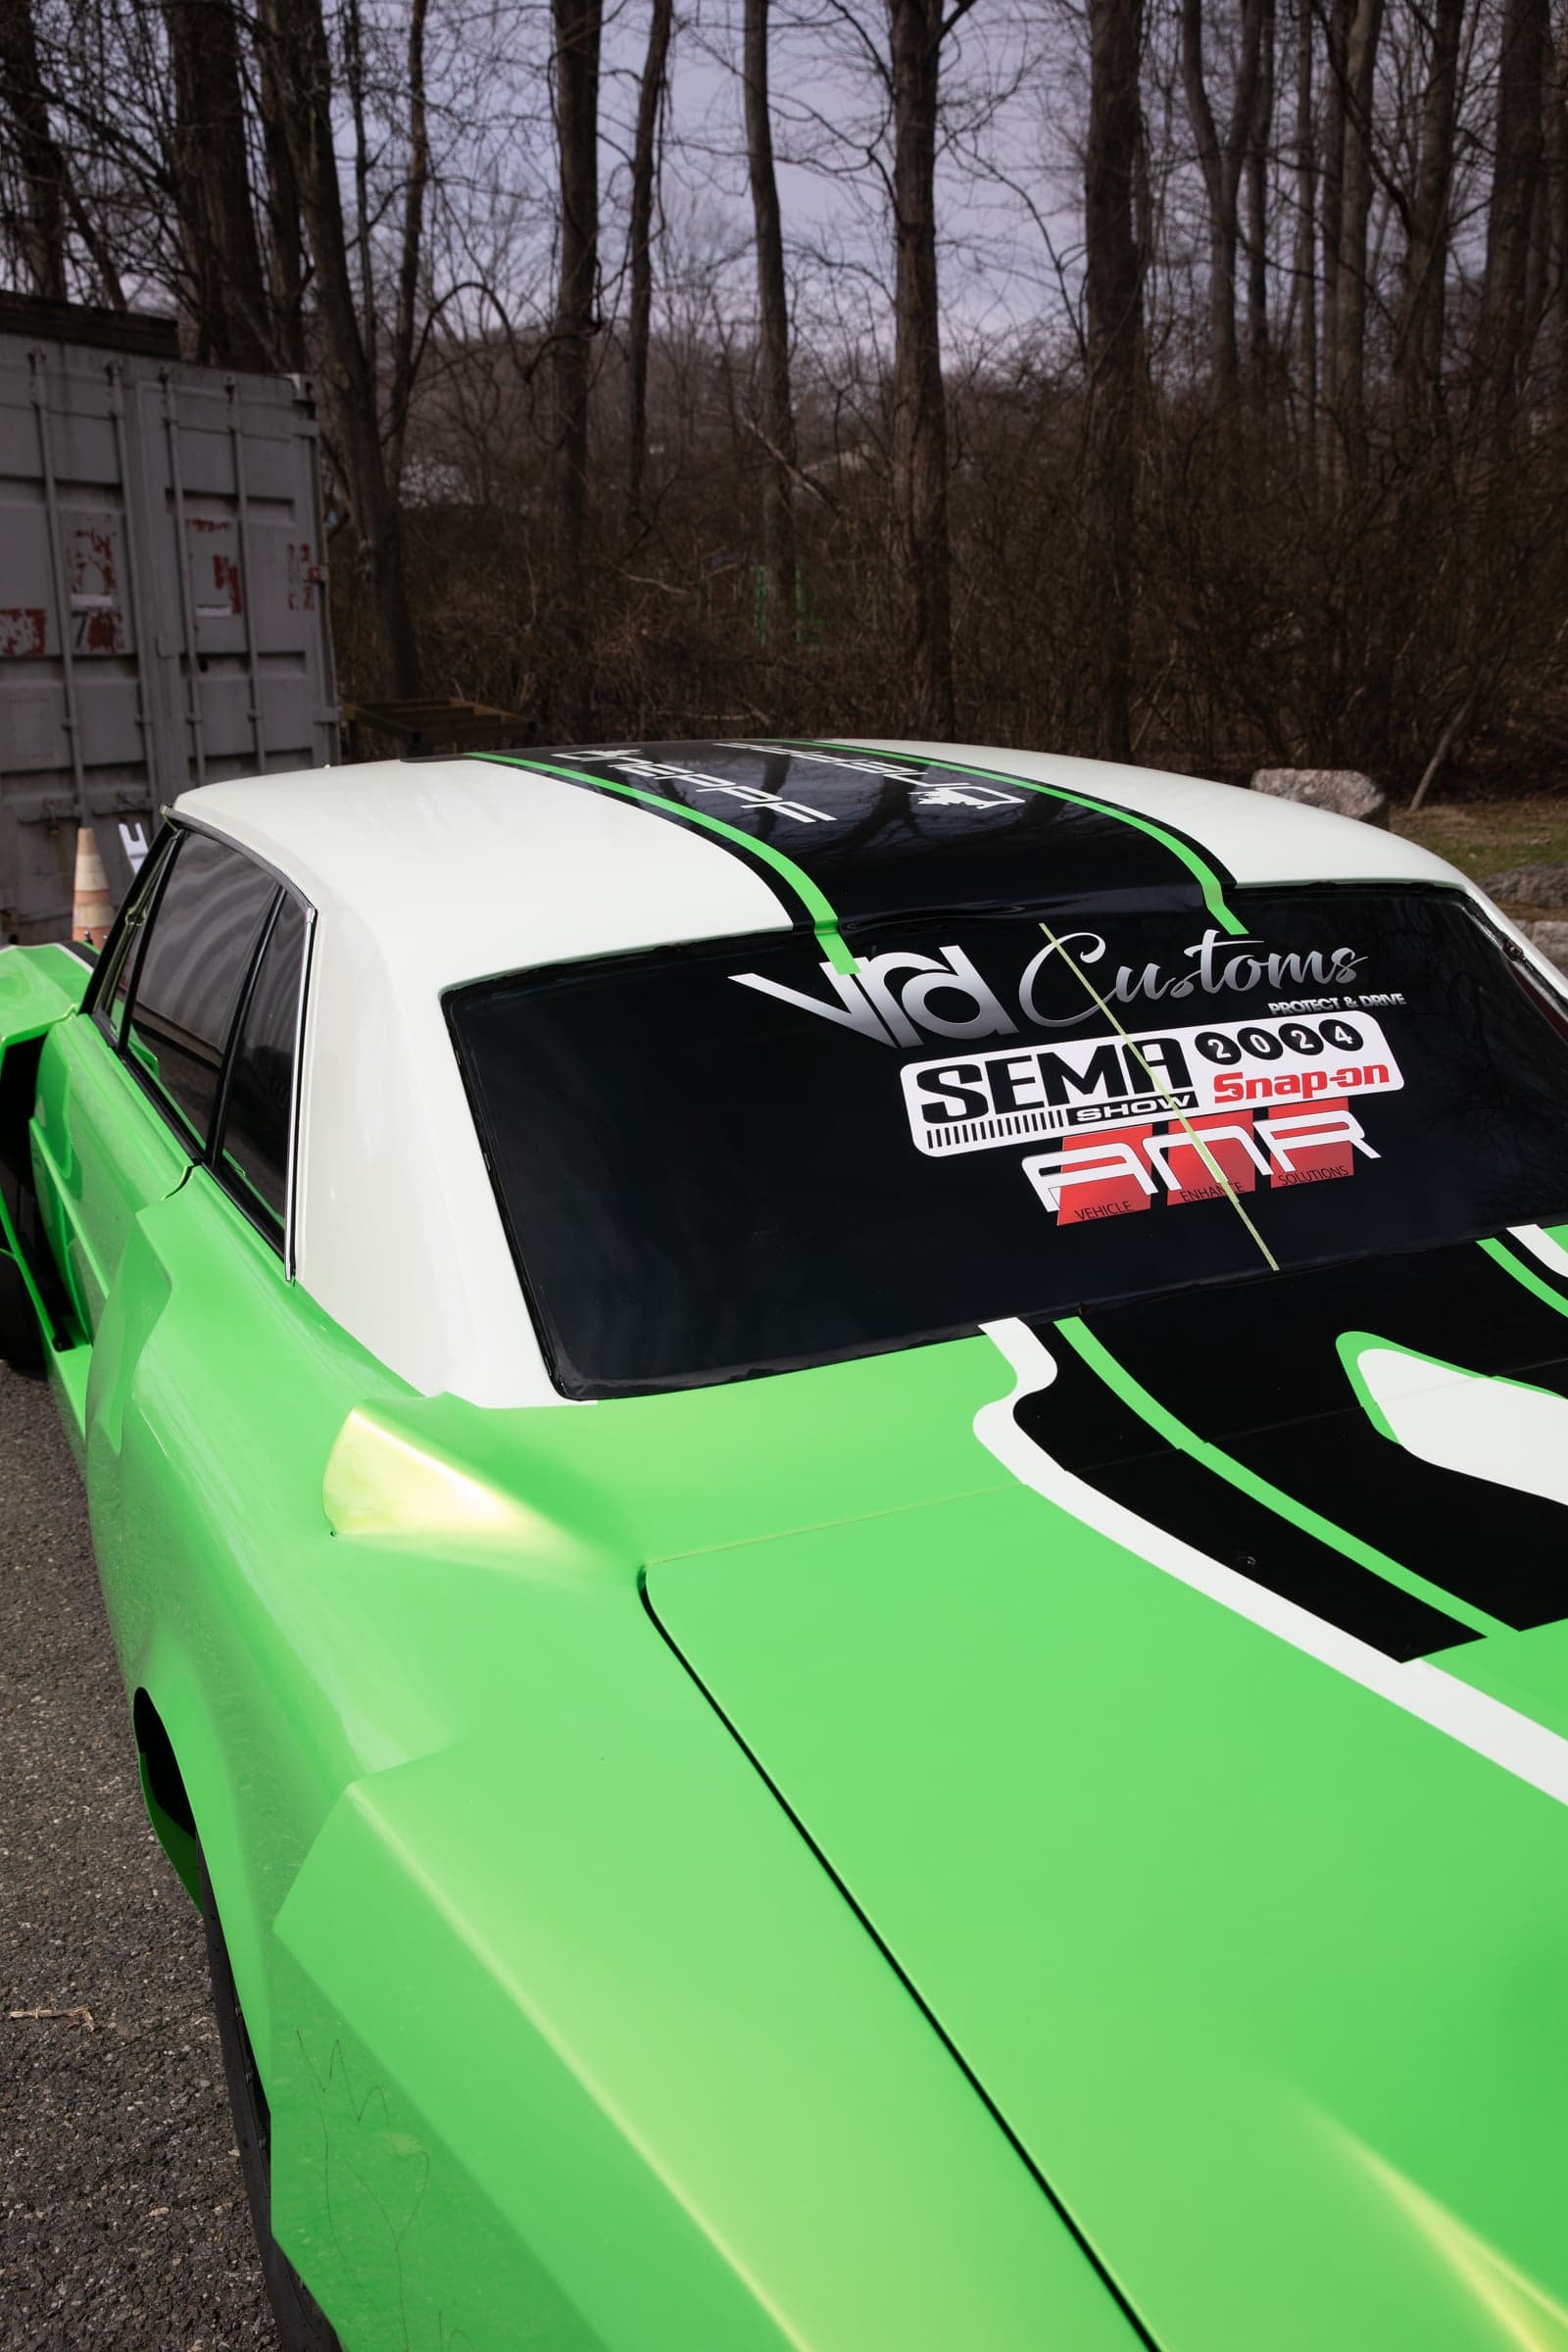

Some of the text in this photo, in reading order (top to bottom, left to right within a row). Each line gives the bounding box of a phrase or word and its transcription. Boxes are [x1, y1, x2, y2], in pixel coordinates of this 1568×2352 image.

[1018, 928, 1368, 1027] Customs
[1267, 993, 1407, 1015] PROTECT & DRIVE
[916, 1038, 1194, 1124] SEMA
[1213, 1063, 1390, 1104] Snap-on
[1076, 1095, 1190, 1122] SHOW
[1074, 1165, 1349, 1221] VEHICLE ENHANE SOLUTIONS
